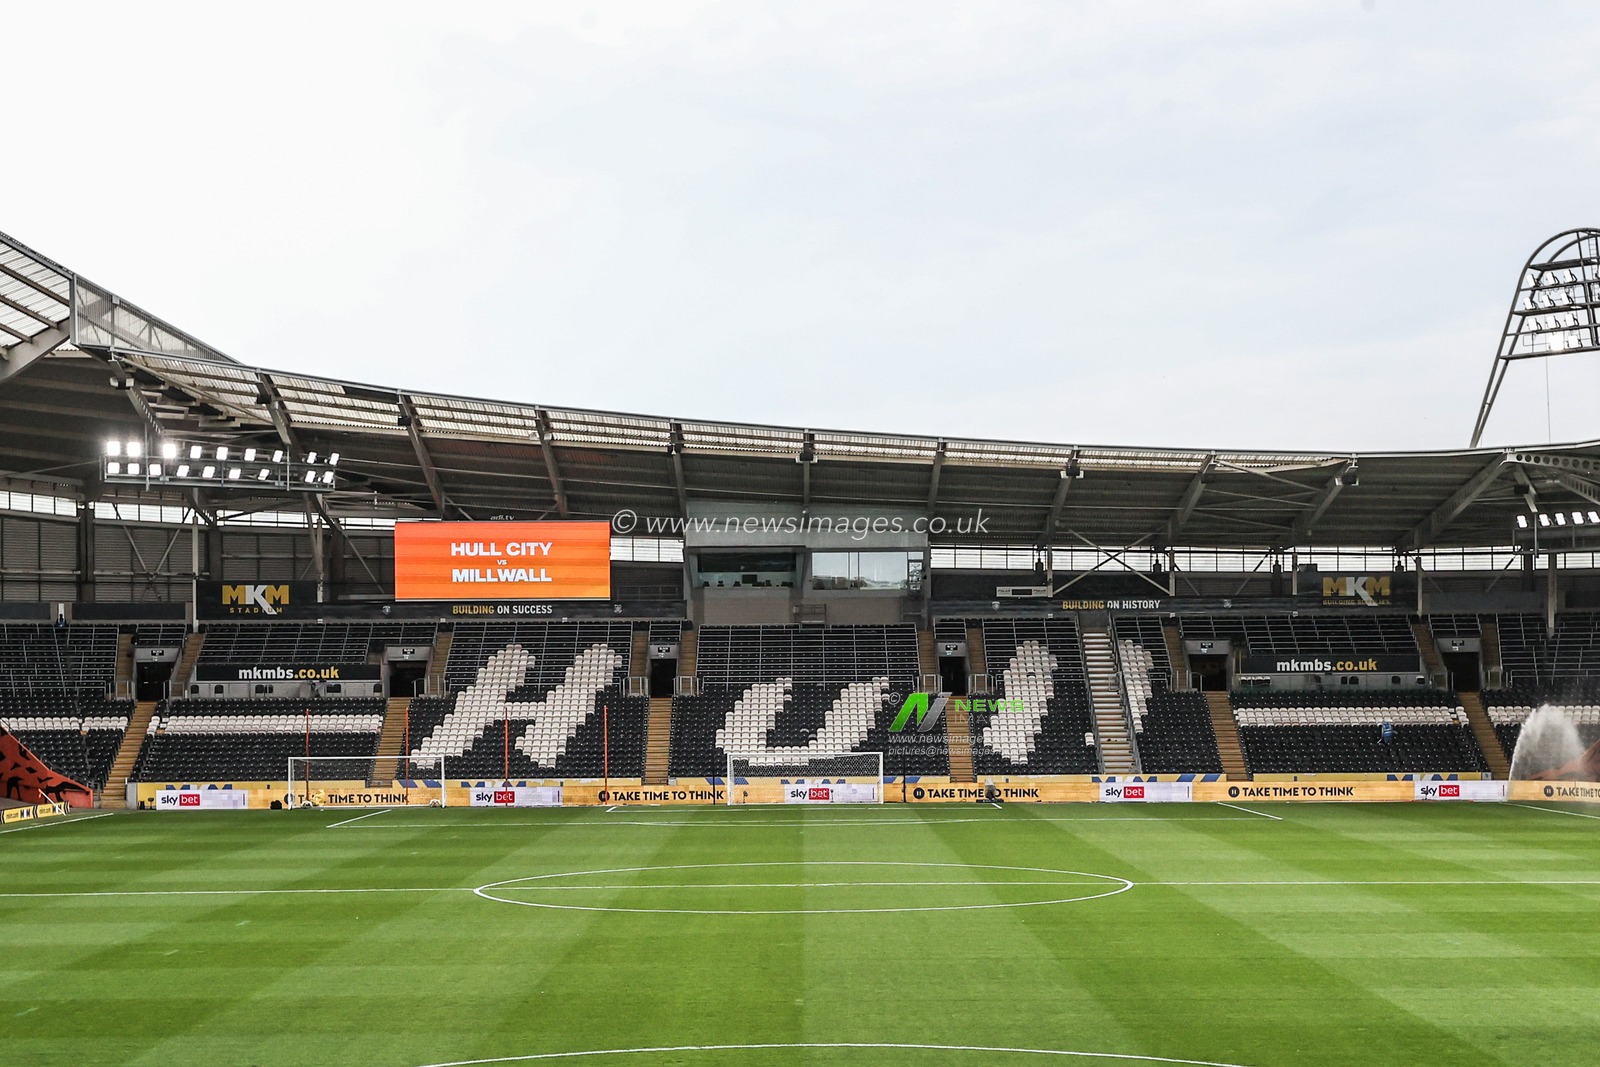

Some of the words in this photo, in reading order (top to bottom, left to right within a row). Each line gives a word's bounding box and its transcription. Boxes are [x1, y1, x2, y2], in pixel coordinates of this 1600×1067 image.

[451, 542, 502, 556] HULL
[505, 542, 553, 556] CITY
[452, 568, 552, 582] MILLWALL
[1322, 576, 1391, 607] MKM
[222, 585, 290, 615] MKM
[1062, 600, 1105, 610] BUILDING
[1107, 600, 1120, 609] ON
[1122, 600, 1161, 609] HISTORY
[452, 605, 495, 615] BUILDING
[497, 605, 510, 614] ON
[512, 605, 553, 614] SUCCESS
[1276, 658, 1378, 671] mkmbs.co.uk
[238, 666, 340, 679] mkmbs.co.uk
[612, 791, 641, 801] TAKE
[643, 791, 669, 801] TIME
[671, 791, 687, 800] TO
[689, 790, 724, 800] THINK
[790, 789, 808, 799] sky
[810, 788, 828, 798] bet
[927, 788, 956, 798] TAKE
[958, 788, 984, 798] TIME
[1003, 788, 1039, 798] THINK
[1105, 787, 1123, 798] sky
[1125, 786, 1143, 796] bet
[1242, 787, 1271, 797] TAKE
[1272, 787, 1299, 797] TIME
[1301, 787, 1317, 796] TO
[1319, 786, 1354, 796] THINK
[1420, 785, 1438, 796] sky
[1441, 785, 1458, 795] bet
[1556, 787, 1580, 797] TAKE
[1580, 787, 1594, 798] TIME
[161, 795, 179, 806] sky
[181, 794, 198, 804] bet
[328, 794, 355, 804] TIME
[356, 794, 372, 804] TO
[375, 794, 409, 803] THINK
[475, 792, 493, 802] sky
[495, 792, 513, 801] bet
